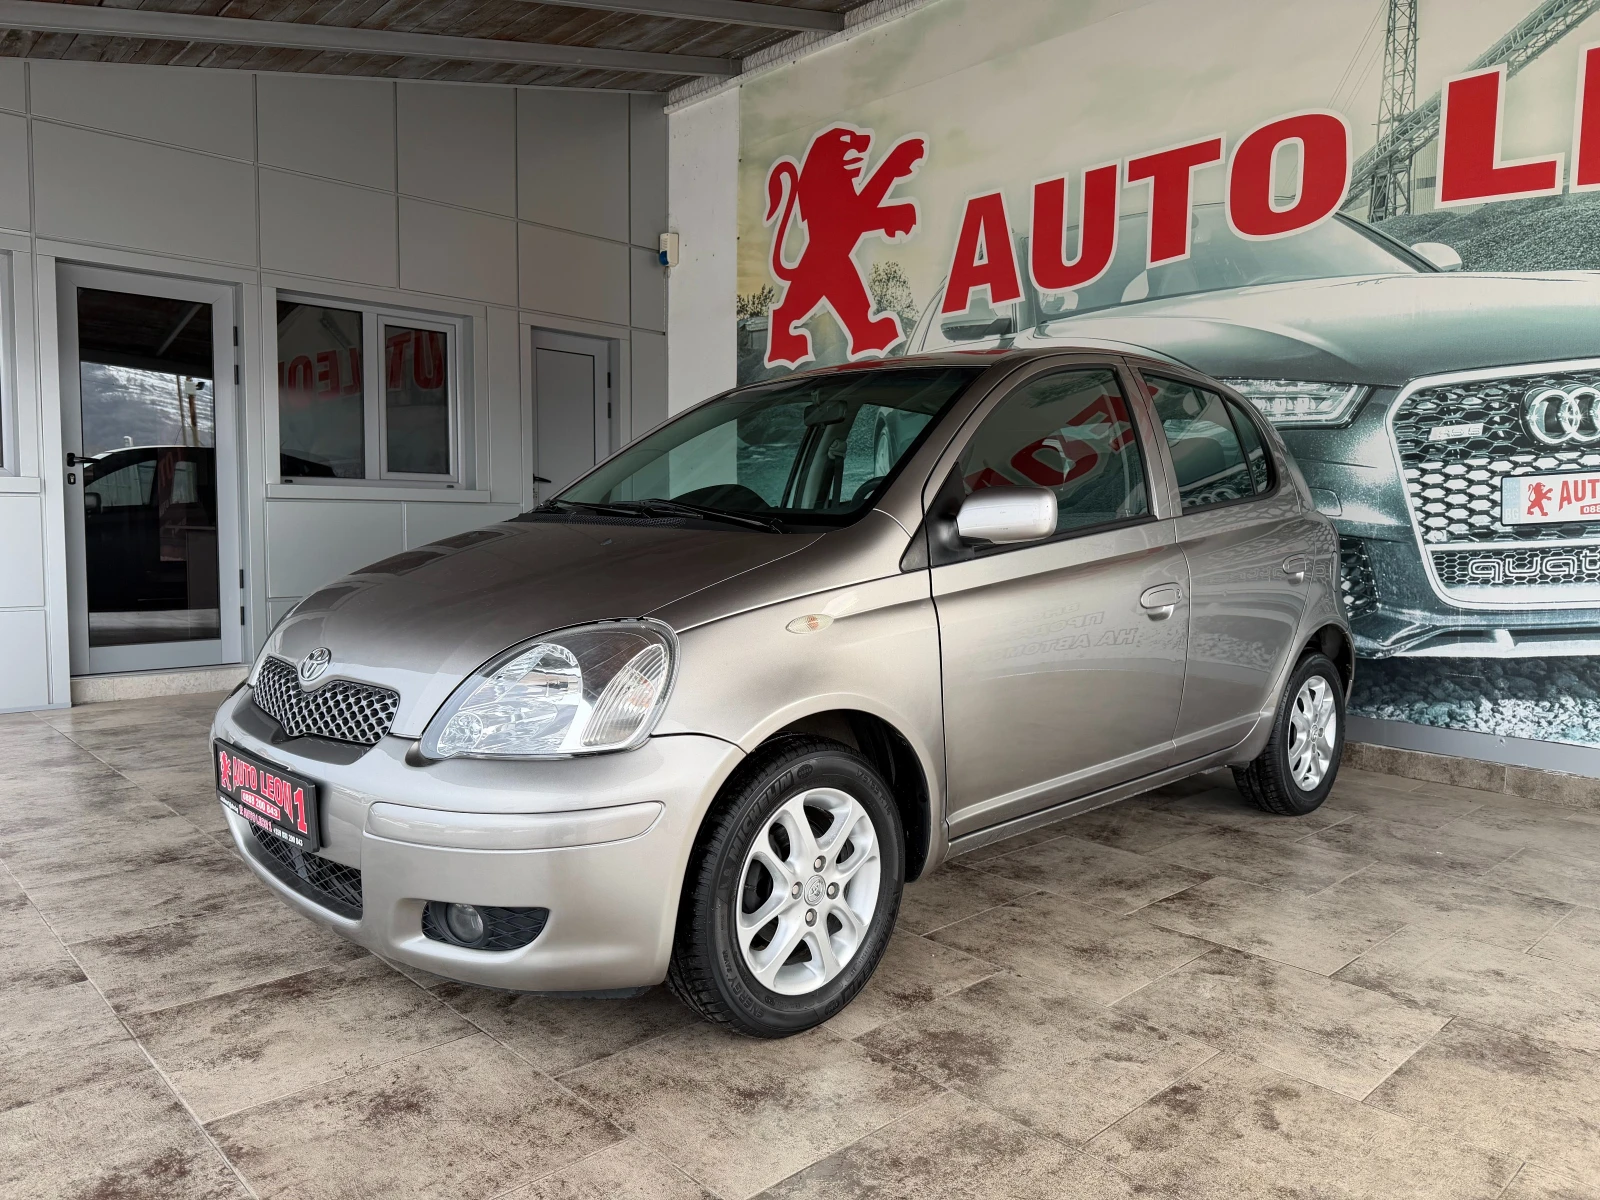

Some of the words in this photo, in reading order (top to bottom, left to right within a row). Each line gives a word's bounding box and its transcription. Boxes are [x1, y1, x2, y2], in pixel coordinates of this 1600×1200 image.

[940, 109, 1350, 316] AUTO
[1505, 508, 1519, 520] BG
[233, 756, 257, 792] AUTO
[260, 770, 293, 823] LEON
[294, 787, 307, 834] 1
[729, 769, 795, 862] MICHELIN
